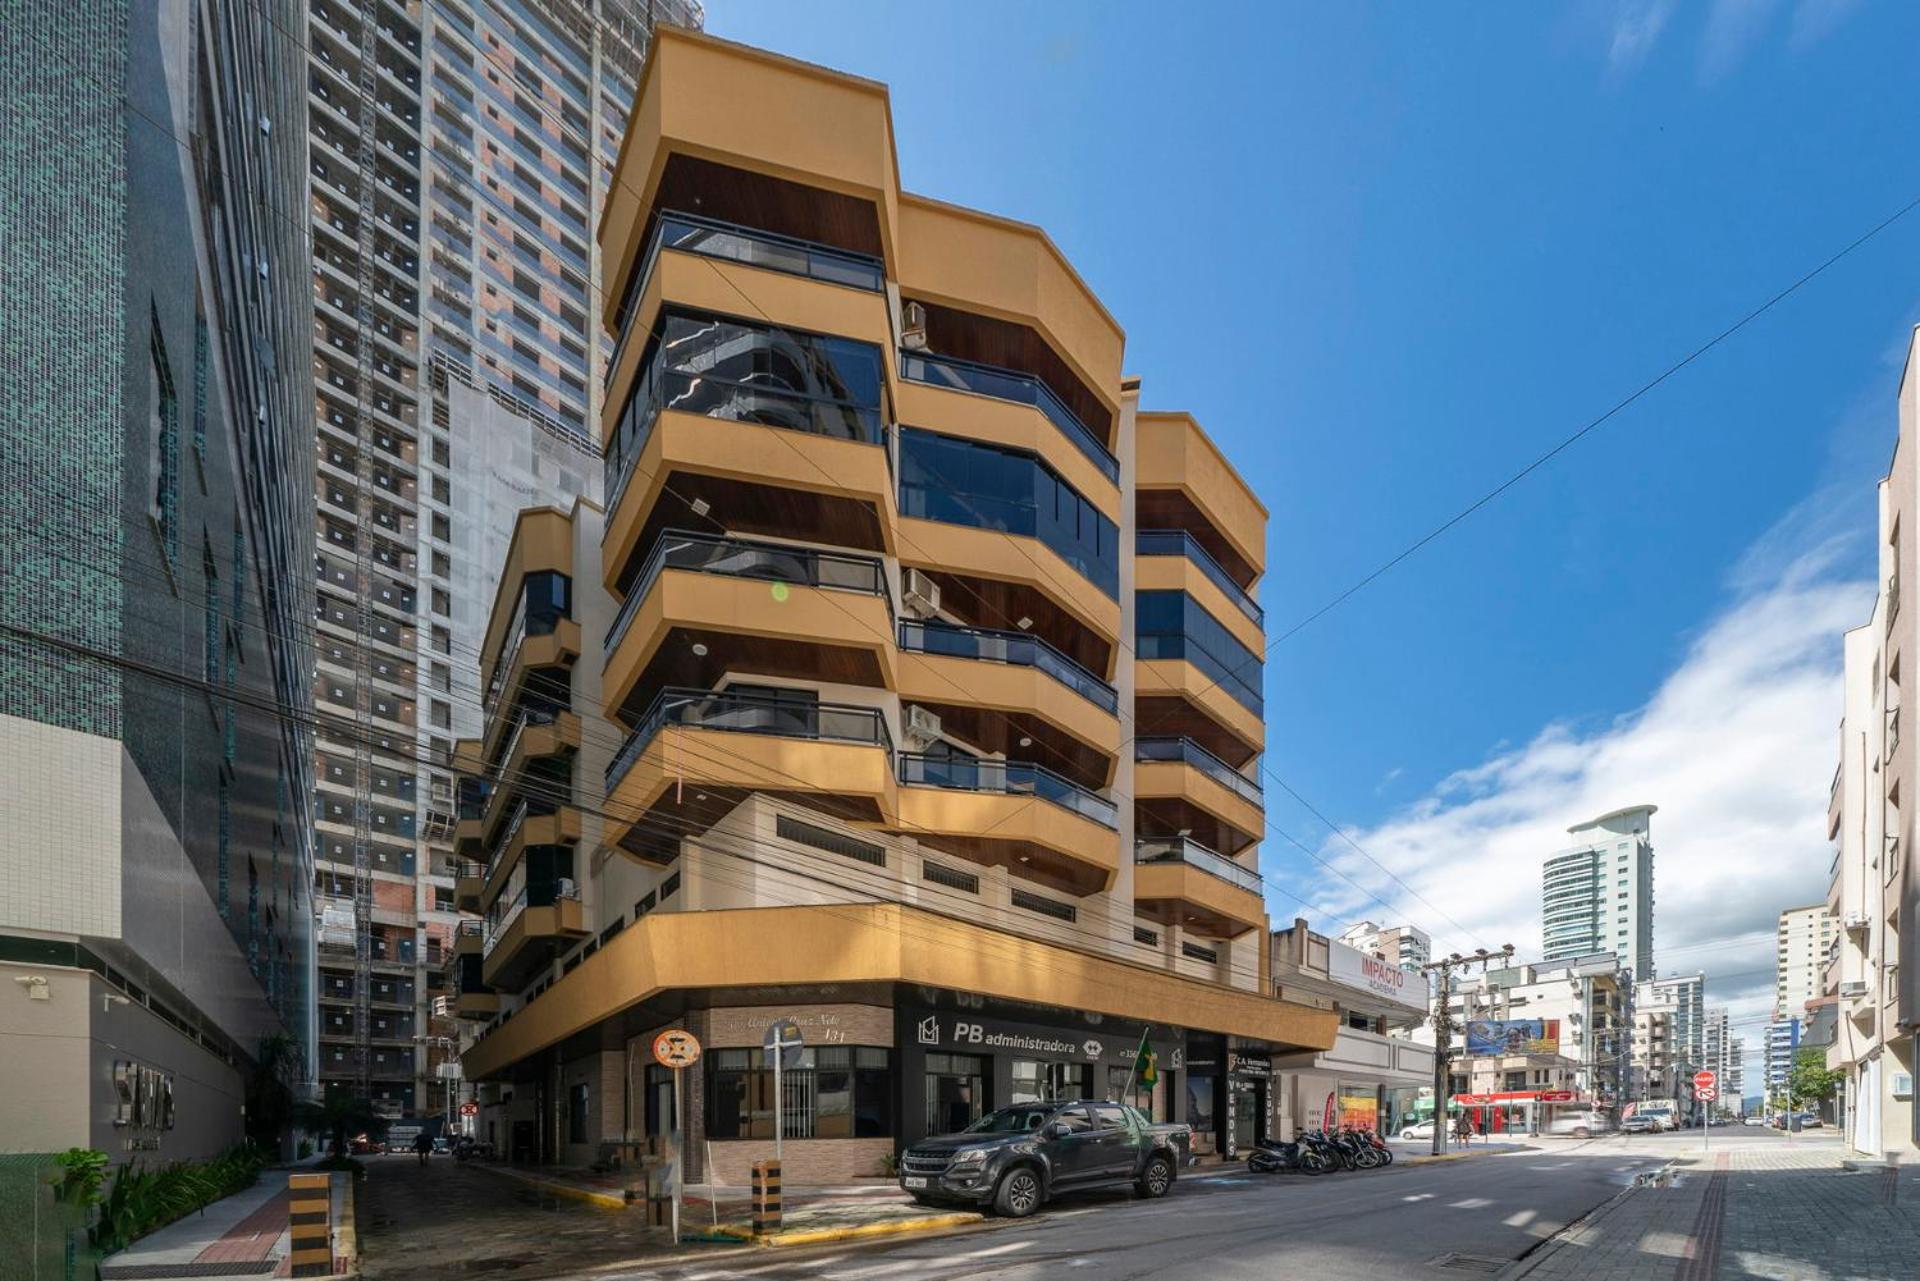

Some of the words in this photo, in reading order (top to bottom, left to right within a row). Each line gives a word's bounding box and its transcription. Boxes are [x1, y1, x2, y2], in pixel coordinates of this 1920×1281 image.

[1362, 956, 1404, 988] IMPACTO
[954, 1022, 984, 1043] PB
[985, 1033, 1076, 1053] administradora
[1228, 1080, 1236, 1156] VENDAS
